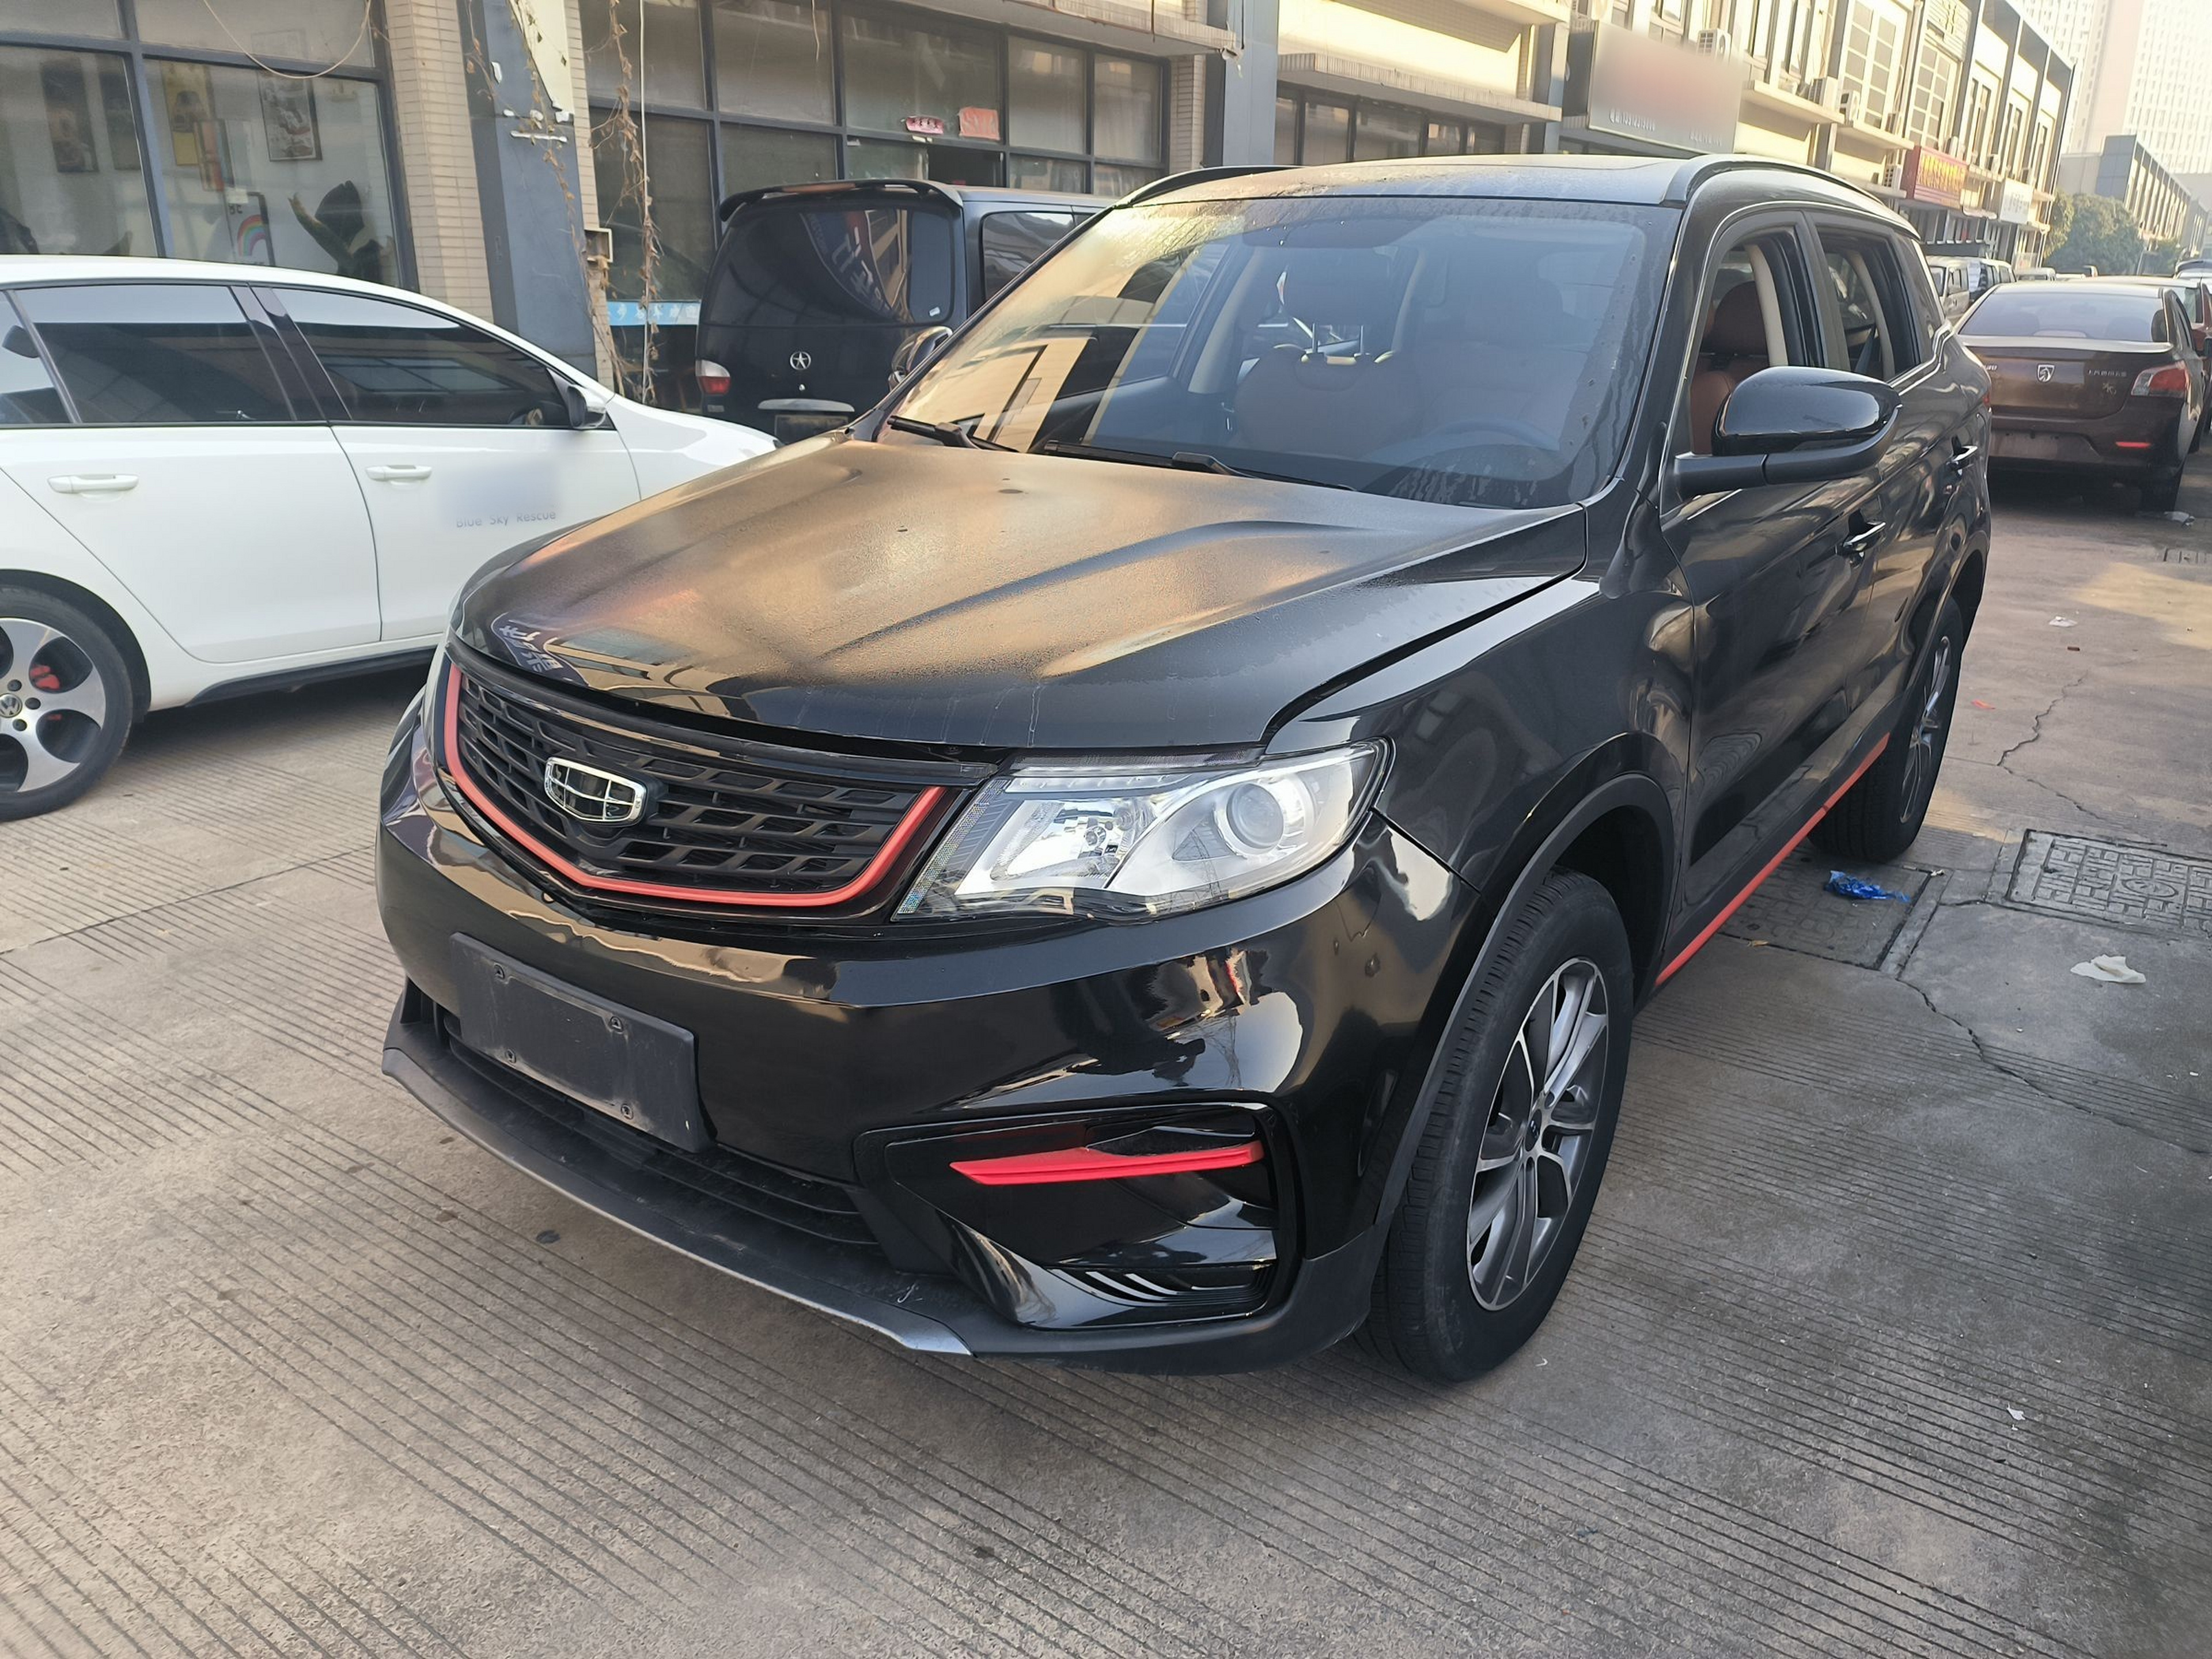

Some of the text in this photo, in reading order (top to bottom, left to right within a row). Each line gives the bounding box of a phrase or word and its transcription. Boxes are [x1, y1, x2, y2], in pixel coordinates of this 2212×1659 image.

[456, 511, 556, 528] Blue Sky Rescue
